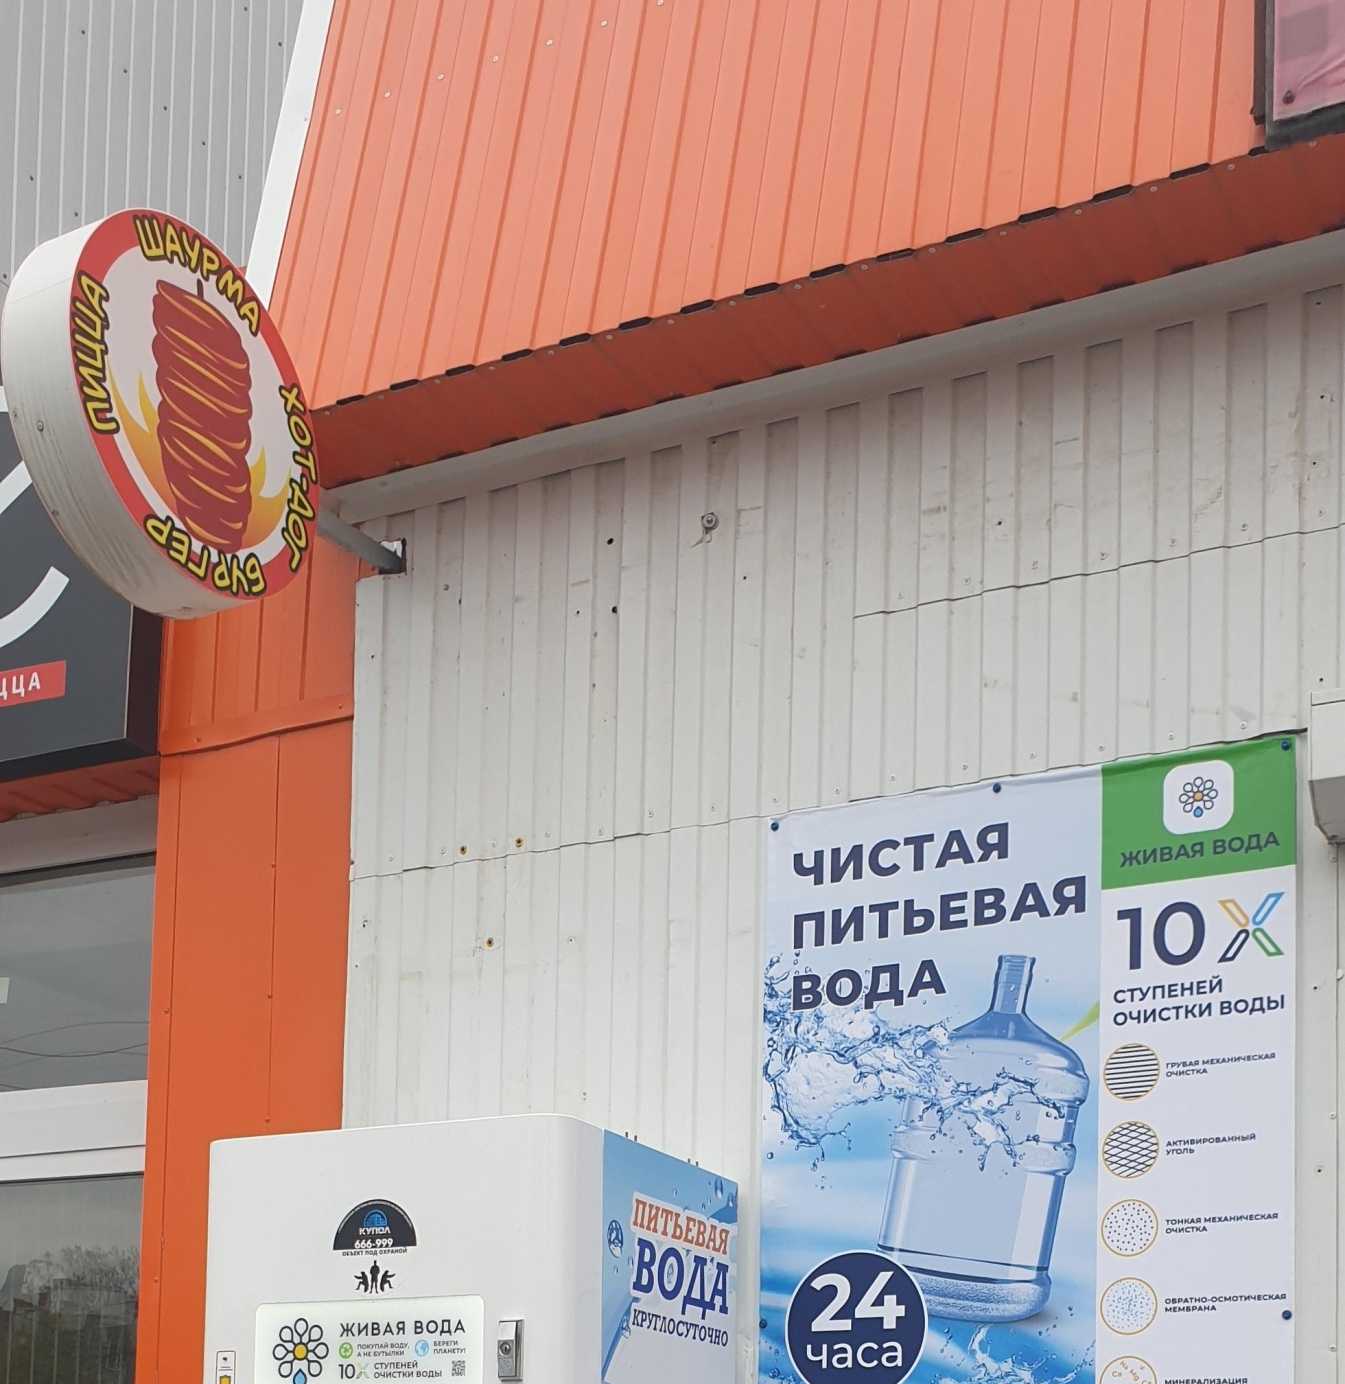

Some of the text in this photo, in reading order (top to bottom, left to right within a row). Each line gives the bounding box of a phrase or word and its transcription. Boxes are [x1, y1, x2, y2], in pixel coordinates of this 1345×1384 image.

[134, 214, 259, 335] ШАУРМА
[76, 272, 120, 434] ПИЦЦА
[279, 384, 318, 570] ХОТ-ДОГ
[145, 514, 266, 596] БУРГЕР
[793, 822, 1009, 885] ЧИСТАЯ
[1120, 831, 1280, 868] ЖИВАЯ ВОДА
[793, 876, 1086, 949] ПИТЬЕВАЯ
[792, 959, 946, 1010] ВОДА
[1113, 975, 1223, 1004] СТУПЕНЕЙ
[1113, 994, 1285, 1026] ОЧИСТКИ ВОДЫ
[1166, 1052, 1276, 1069] ГРУБАЯ МЕХАНИЧЕСКАЯ
[1166, 1068, 1208, 1077] ОЧИСТКА
[1166, 1133, 1256, 1147] АКТИВИРОВАННЫЙ
[633, 1199, 730, 1255] ПИТЬЕВАЯ
[1165, 1226, 1208, 1234] ОЧИСТКА
[1204, 1213, 1279, 1223] МЕХАНИЧЕСКАЯ
[354, 1238, 393, 1249] 666-999
[632, 1237, 729, 1320] ВОДА
[810, 1271, 906, 1332] 24
[1164, 1294, 1287, 1305] ОБРАТНО-ОСМОТИЧЕСКАЯ
[1164, 1305, 1217, 1313] МЕМБРАНА
[339, 1319, 466, 1337] ЖИВАЯ ВОДА
[632, 1309, 728, 1347] КРУГЛОСУТОЧНО
[374, 1360, 418, 1370] СТУПЕНЕЙ
[806, 1340, 903, 1369] часа
[373, 1370, 442, 1379] ОЧИСТКИ ВОДЫ
